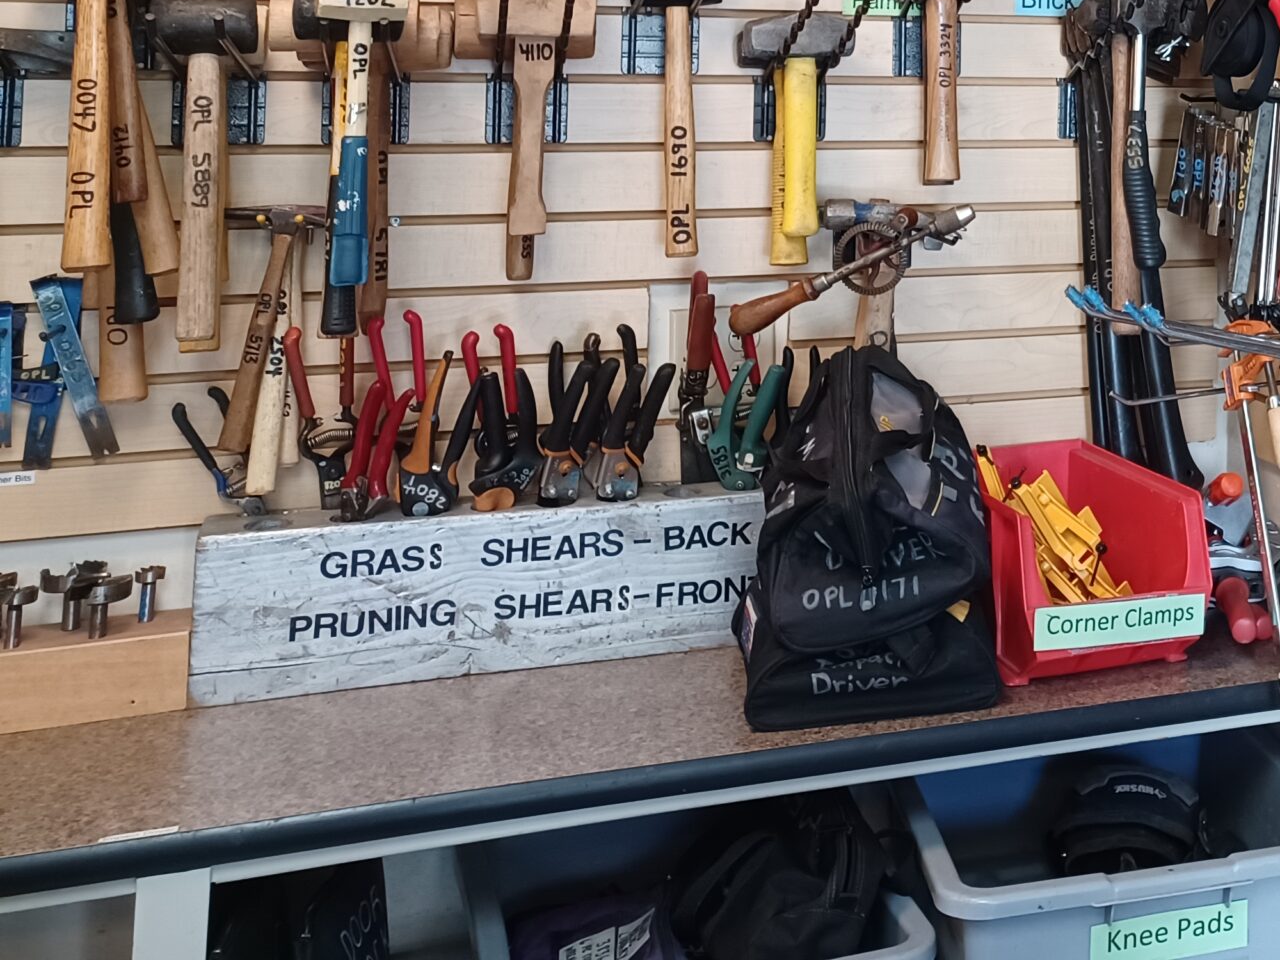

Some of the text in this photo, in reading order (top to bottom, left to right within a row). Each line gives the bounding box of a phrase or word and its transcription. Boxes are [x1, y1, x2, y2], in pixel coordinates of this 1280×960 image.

[353, 43, 368, 80] OPL
[940, 64, 952, 88] OPL
[73, 79, 96, 133] 0047
[192, 96, 212, 130] OPL
[671, 125, 687, 177] 1690
[69, 171, 94, 219] OPL
[671, 203, 692, 244] OPL
[260, 292, 273, 320] OPL
[21, 370, 50, 380] OPL
[15, 474, 32, 483] Bits
[320, 542, 444, 579] GRASS
[480, 529, 625, 567] SHEARS
[663, 521, 753, 551] BACK
[802, 586, 853, 610] OPL
[289, 598, 456, 642] PRUNING
[1046, 604, 1195, 636] Corner Clamps
[811, 672, 909, 695] Driver
[1107, 909, 1235, 955] Knee Pads
